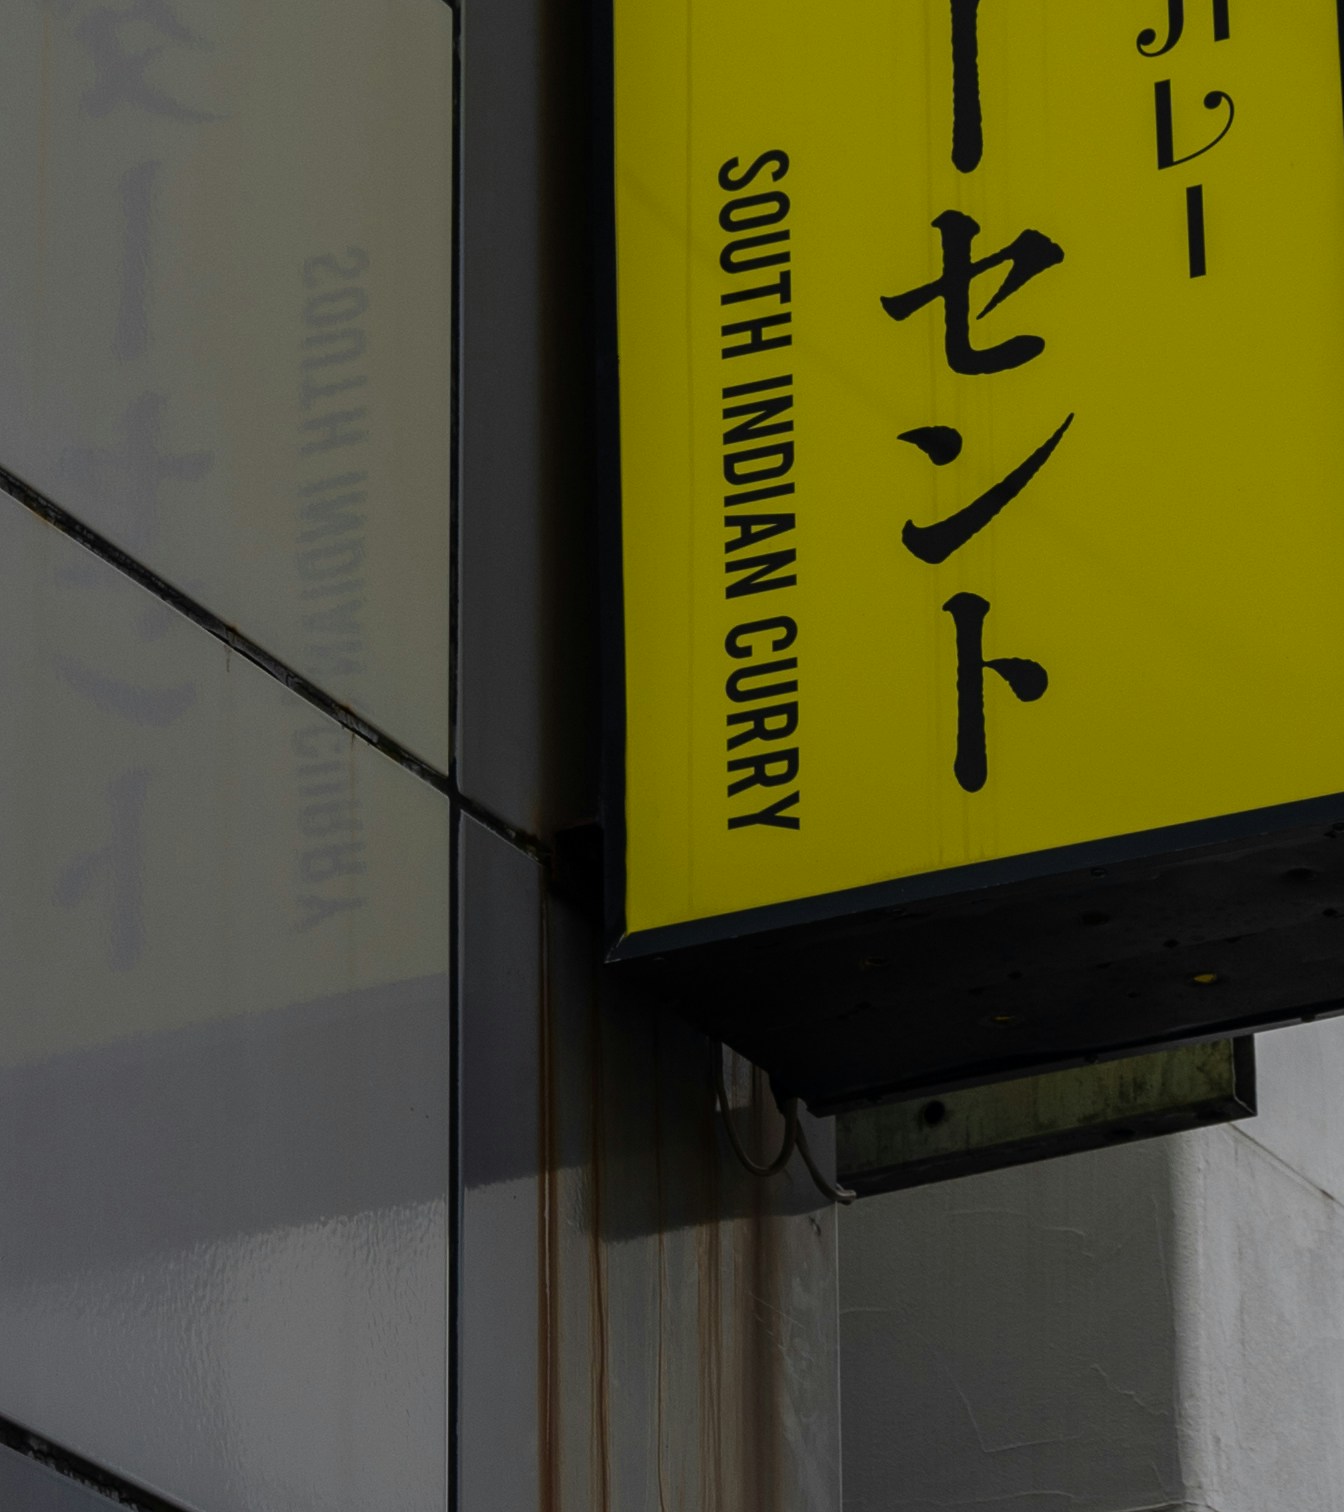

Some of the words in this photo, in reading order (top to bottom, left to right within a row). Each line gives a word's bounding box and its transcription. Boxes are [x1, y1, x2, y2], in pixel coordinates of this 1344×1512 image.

[717, 149, 793, 360] SOUTH
[721, 373, 797, 600] INDIAN
[724, 615, 801, 831] CURRY
